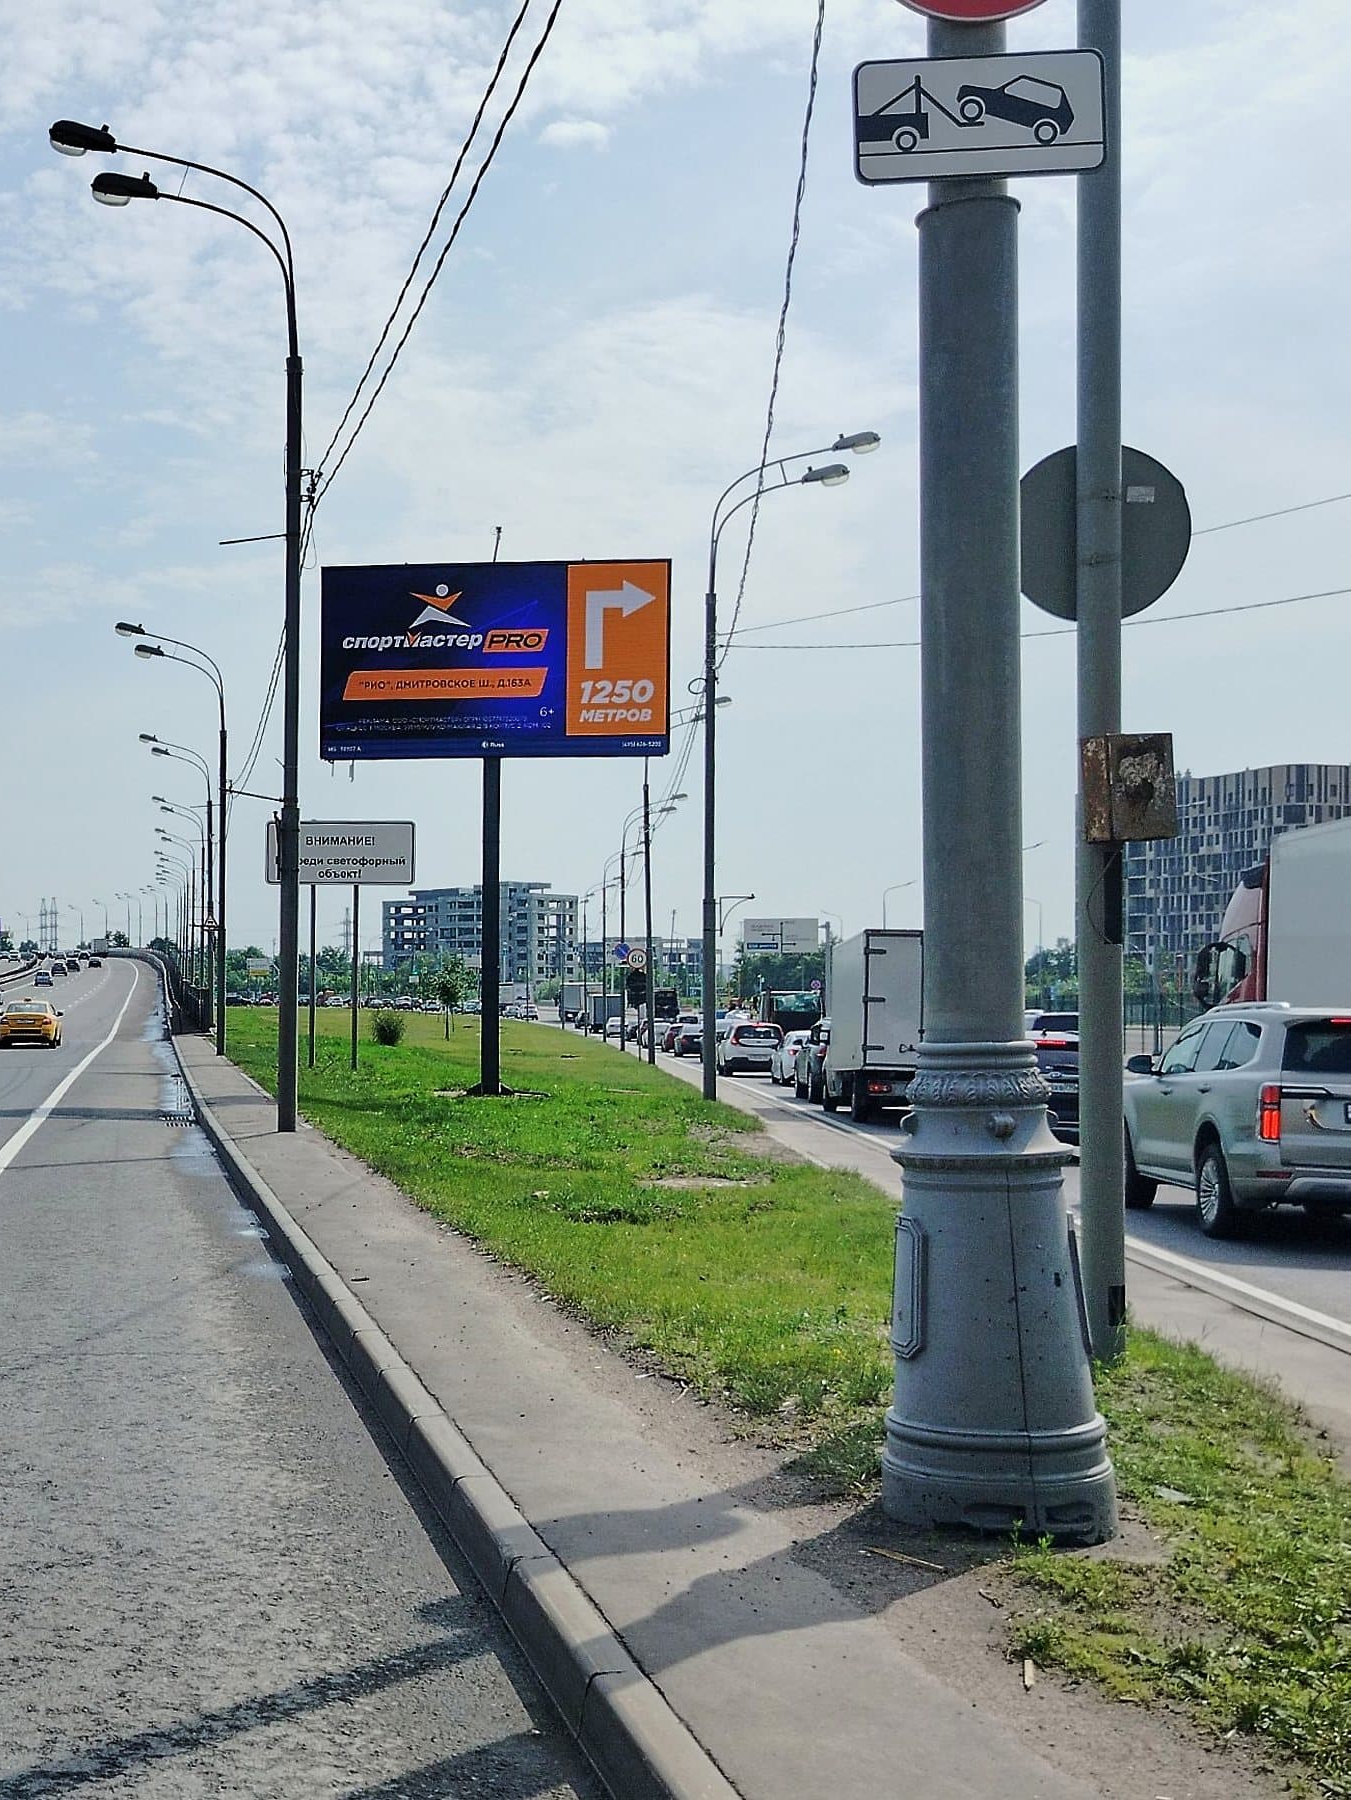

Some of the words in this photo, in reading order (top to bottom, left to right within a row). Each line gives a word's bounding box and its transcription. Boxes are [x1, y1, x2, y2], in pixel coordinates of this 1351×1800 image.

[487, 633, 543, 649] PRO
[395, 679, 475, 690] ДМИТРОВСКОЕ
[579, 679, 655, 705] 1250
[539, 706, 555, 718] 6+
[579, 708, 653, 724] МЕТРОВ
[305, 836, 376, 847] ВНИМАНИЕ!
[326, 855, 406, 868] светофорный
[317, 868, 362, 879] объект!
[631, 954, 644, 963] 60
